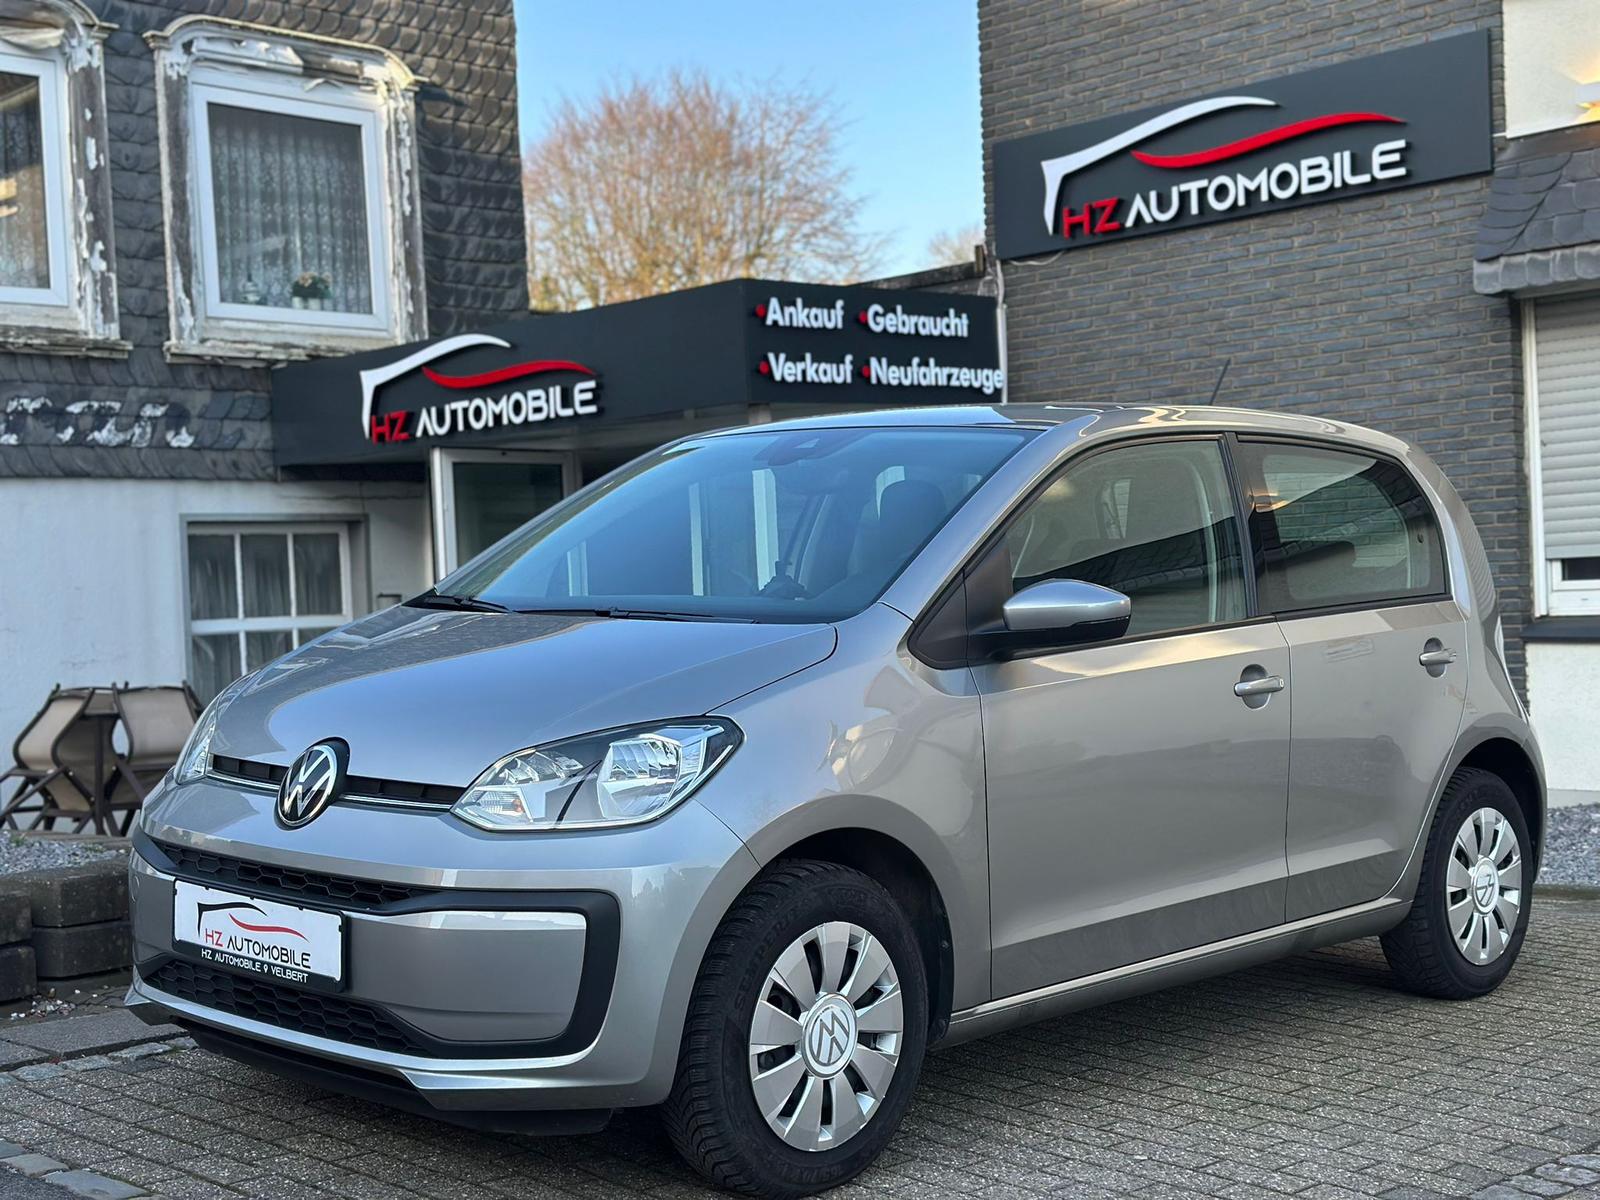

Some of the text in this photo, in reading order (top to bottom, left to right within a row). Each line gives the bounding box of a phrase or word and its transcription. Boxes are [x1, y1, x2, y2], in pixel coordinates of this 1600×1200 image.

[1063, 139, 1406, 239] HZ AUTOMOBILE
[766, 297, 969, 338] Ankauf Gebraucht
[767, 352, 1004, 394] Verkauf Neufahrzeuge
[371, 380, 597, 443] HZ AUTOMOBILE
[201, 948, 308, 983] HZ AUTOMOBILE VELBERT
[205, 929, 311, 969] HZ AUTOMOBILE
